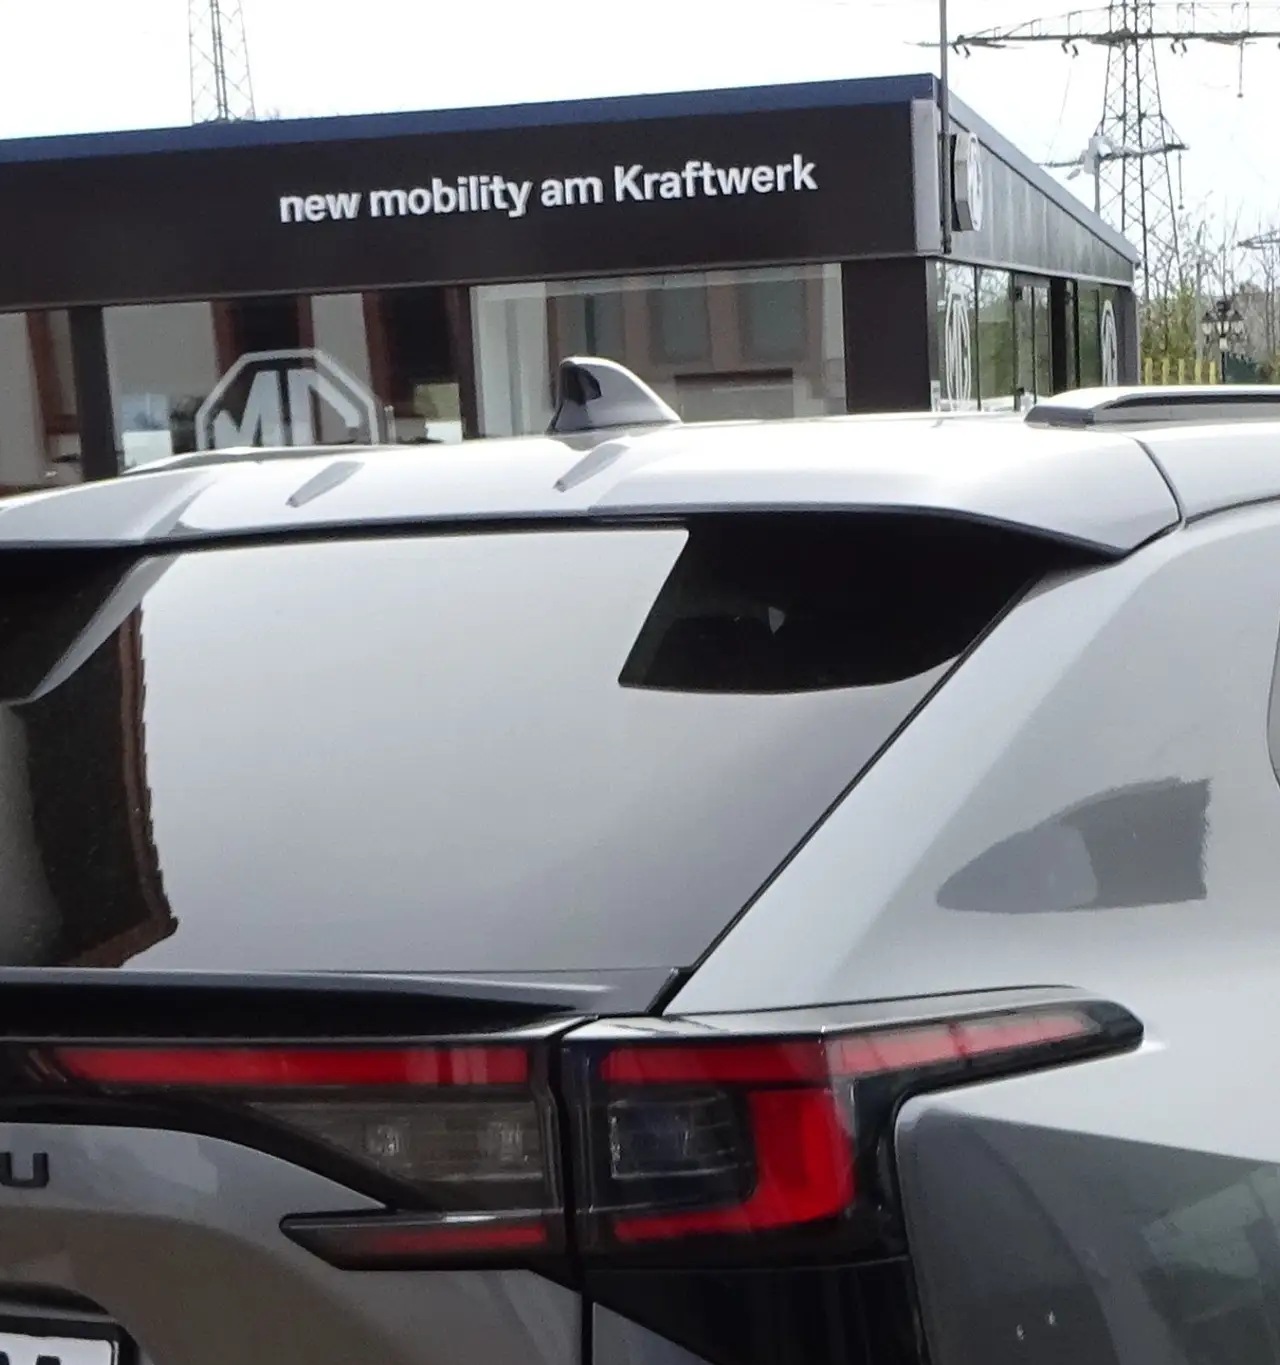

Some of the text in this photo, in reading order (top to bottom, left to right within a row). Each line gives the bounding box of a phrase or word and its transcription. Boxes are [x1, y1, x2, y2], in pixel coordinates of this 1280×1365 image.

[279, 153, 819, 223] new mobility am Kraftwerk
